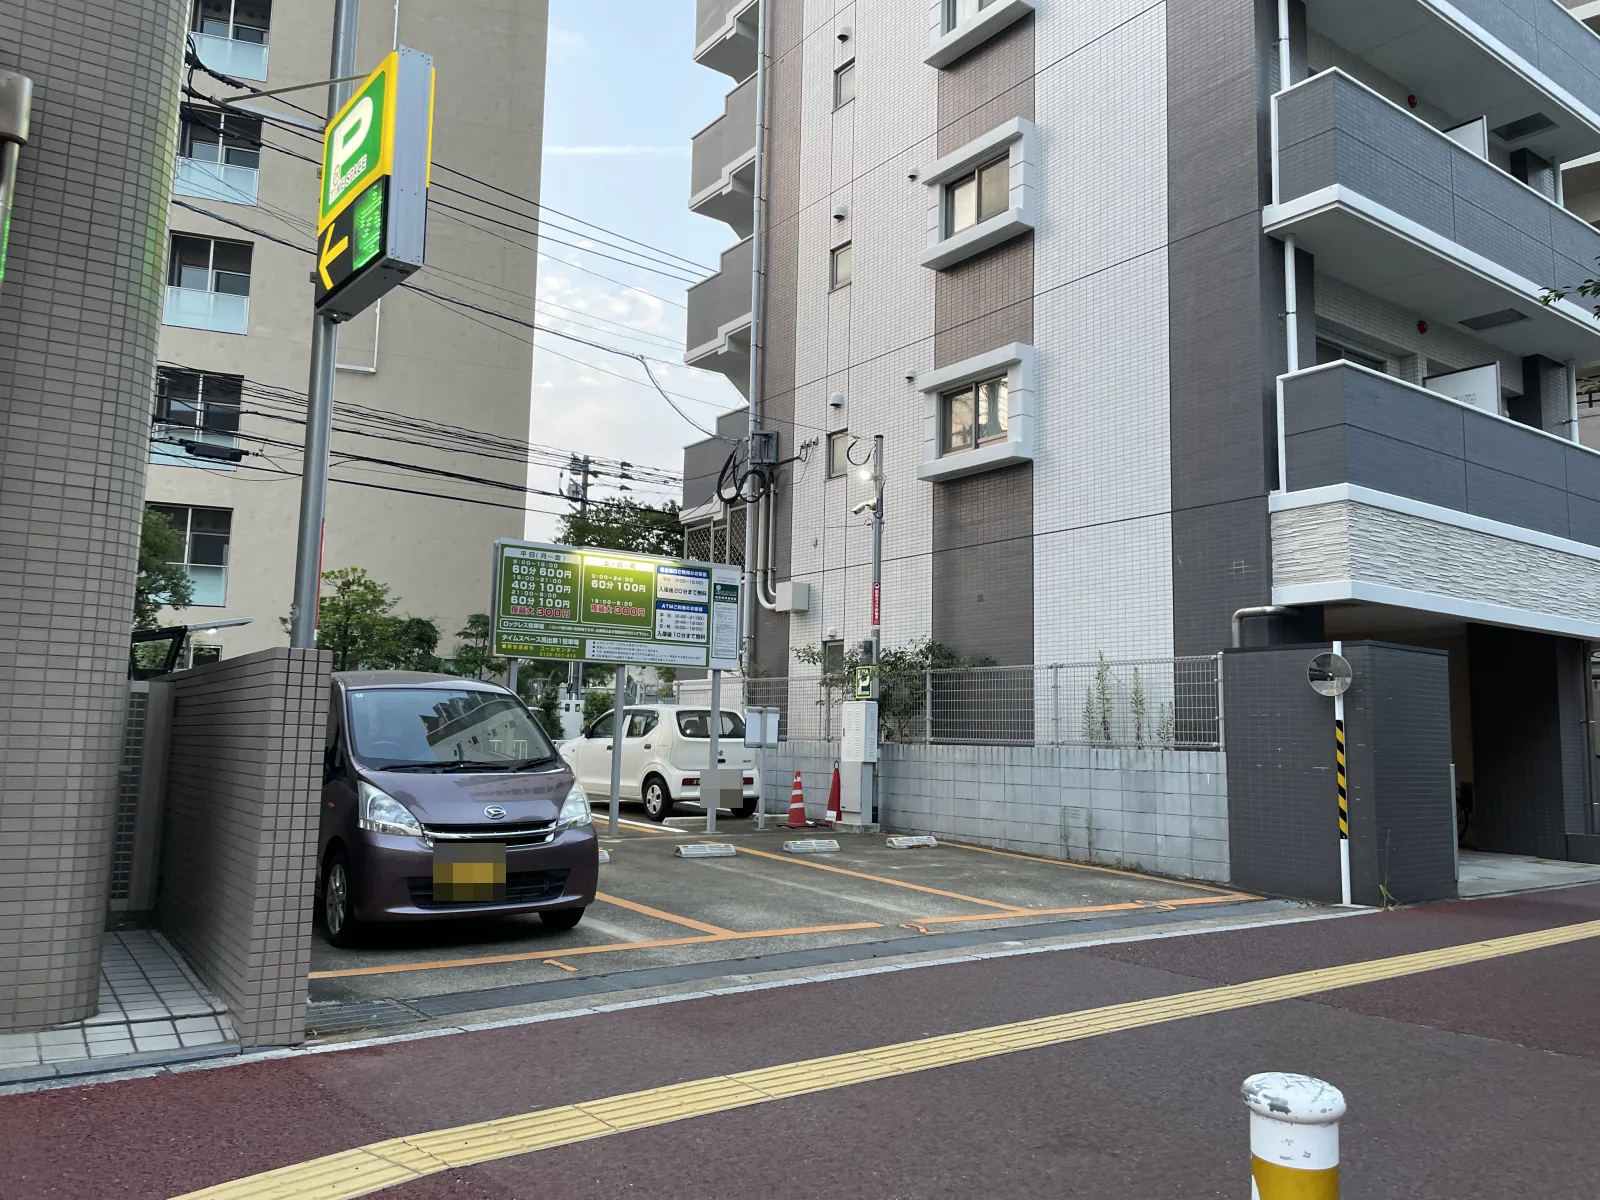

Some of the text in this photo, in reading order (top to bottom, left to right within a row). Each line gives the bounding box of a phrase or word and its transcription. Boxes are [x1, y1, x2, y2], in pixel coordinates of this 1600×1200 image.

[331, 96, 373, 192] P
[512, 565, 572, 579] 60分 600円
[511, 580, 571, 593] 40分 100円
[591, 580, 646, 593] 60分 100円
[510, 595, 570, 608] 60分 100円
[536, 607, 570, 618] 300円
[614, 606, 645, 617] 300円
